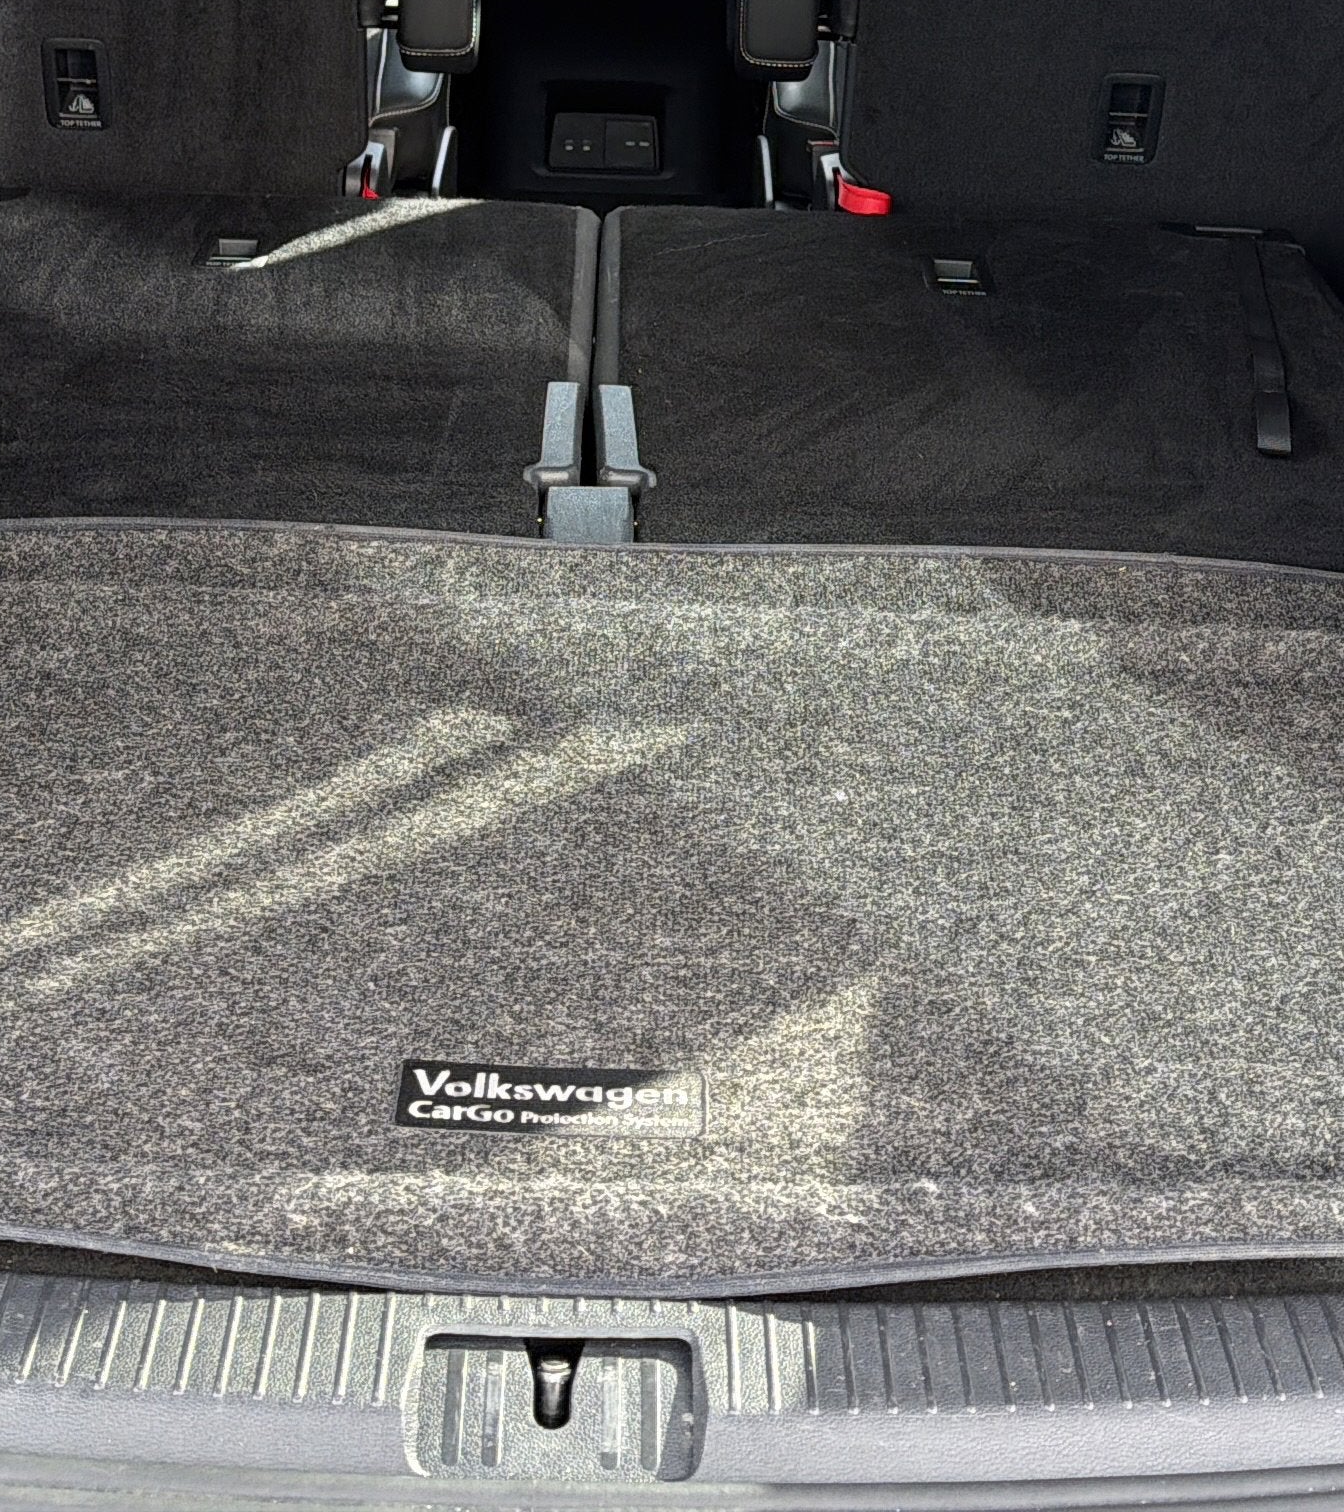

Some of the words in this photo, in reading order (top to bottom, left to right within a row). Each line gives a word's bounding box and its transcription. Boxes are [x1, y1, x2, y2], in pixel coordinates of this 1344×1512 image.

[59, 119, 75, 127] TOP
[76, 119, 102, 128] TETHER
[1103, 153, 1118, 161] TOP
[1119, 154, 1145, 163] TETHER
[412, 1068, 689, 1110] Volkswagen
[408, 1100, 515, 1124] CarGo
